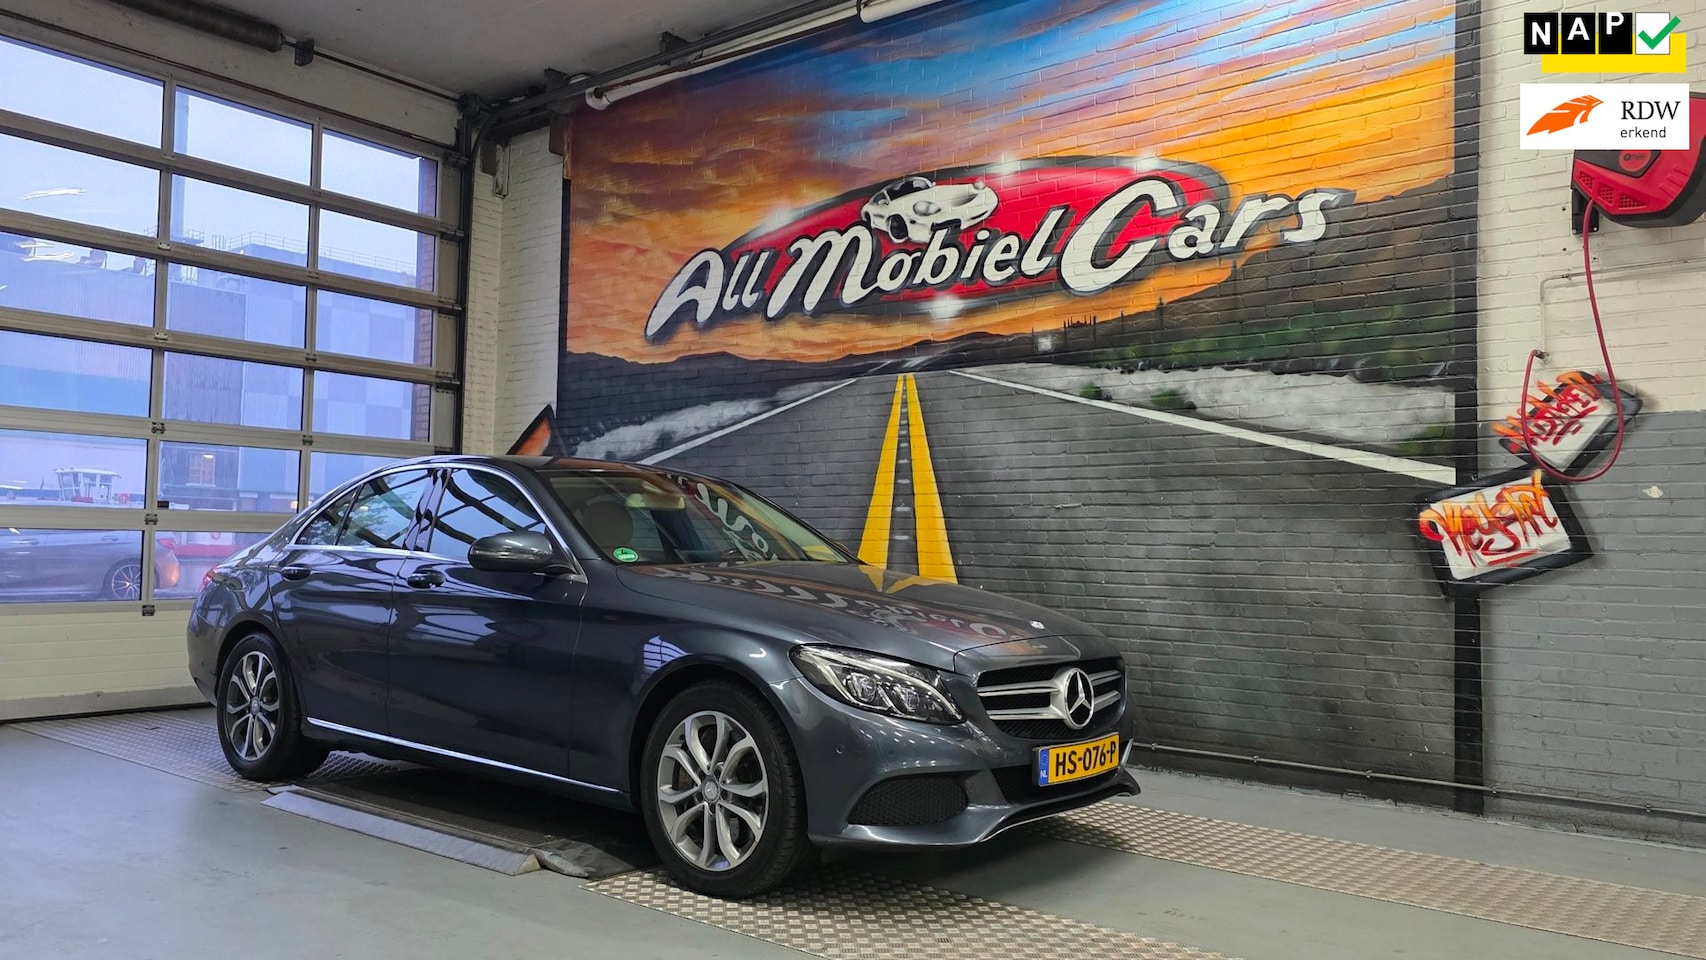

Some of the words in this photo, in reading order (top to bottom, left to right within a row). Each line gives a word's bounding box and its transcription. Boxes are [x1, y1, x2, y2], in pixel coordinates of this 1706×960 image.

[645, 249, 770, 338] All
[766, 207, 1060, 319] Mobiel
[1059, 178, 1345, 293] Cars
[1040, 769, 1048, 779] NL
[1055, 741, 1117, 777] HS-076-P
